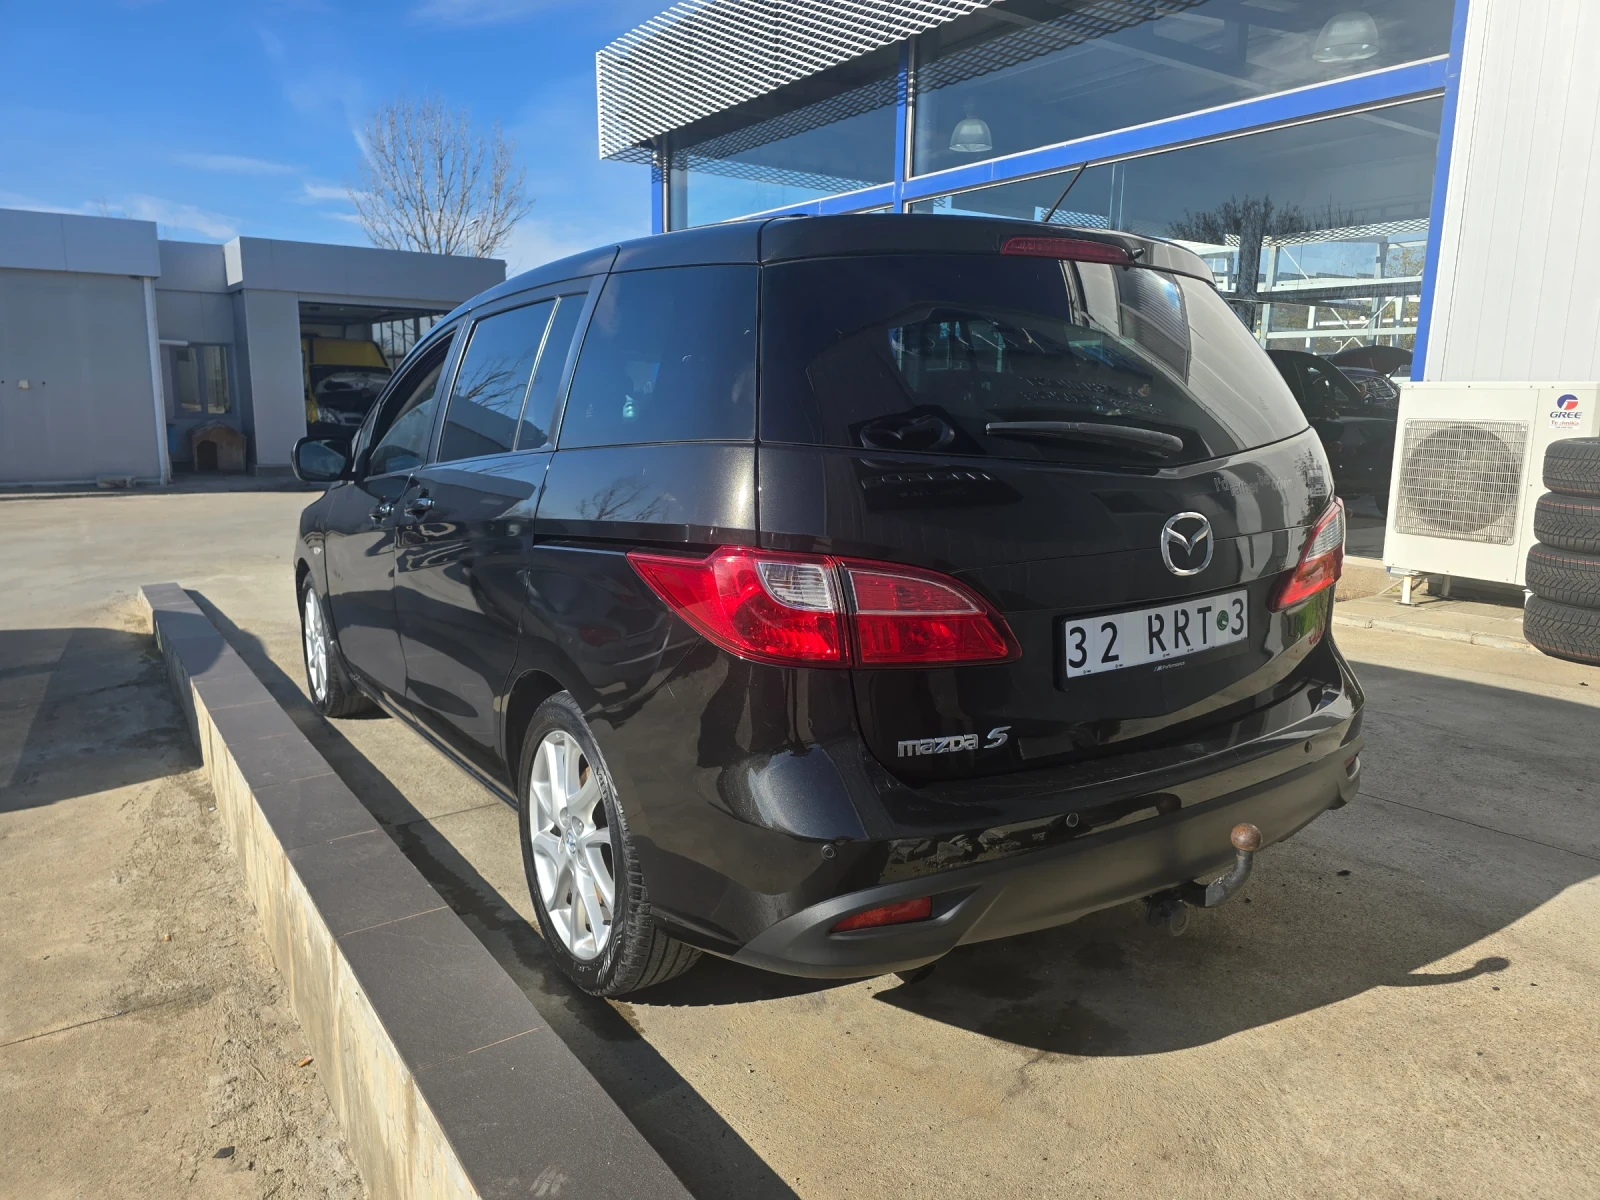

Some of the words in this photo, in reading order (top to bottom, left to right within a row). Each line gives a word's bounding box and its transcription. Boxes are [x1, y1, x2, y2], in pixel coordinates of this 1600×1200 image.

[1550, 411, 1582, 419] GREE
[1230, 480, 1259, 496] rather
[1147, 606, 1212, 654] RRT
[1231, 598, 1244, 635] 3
